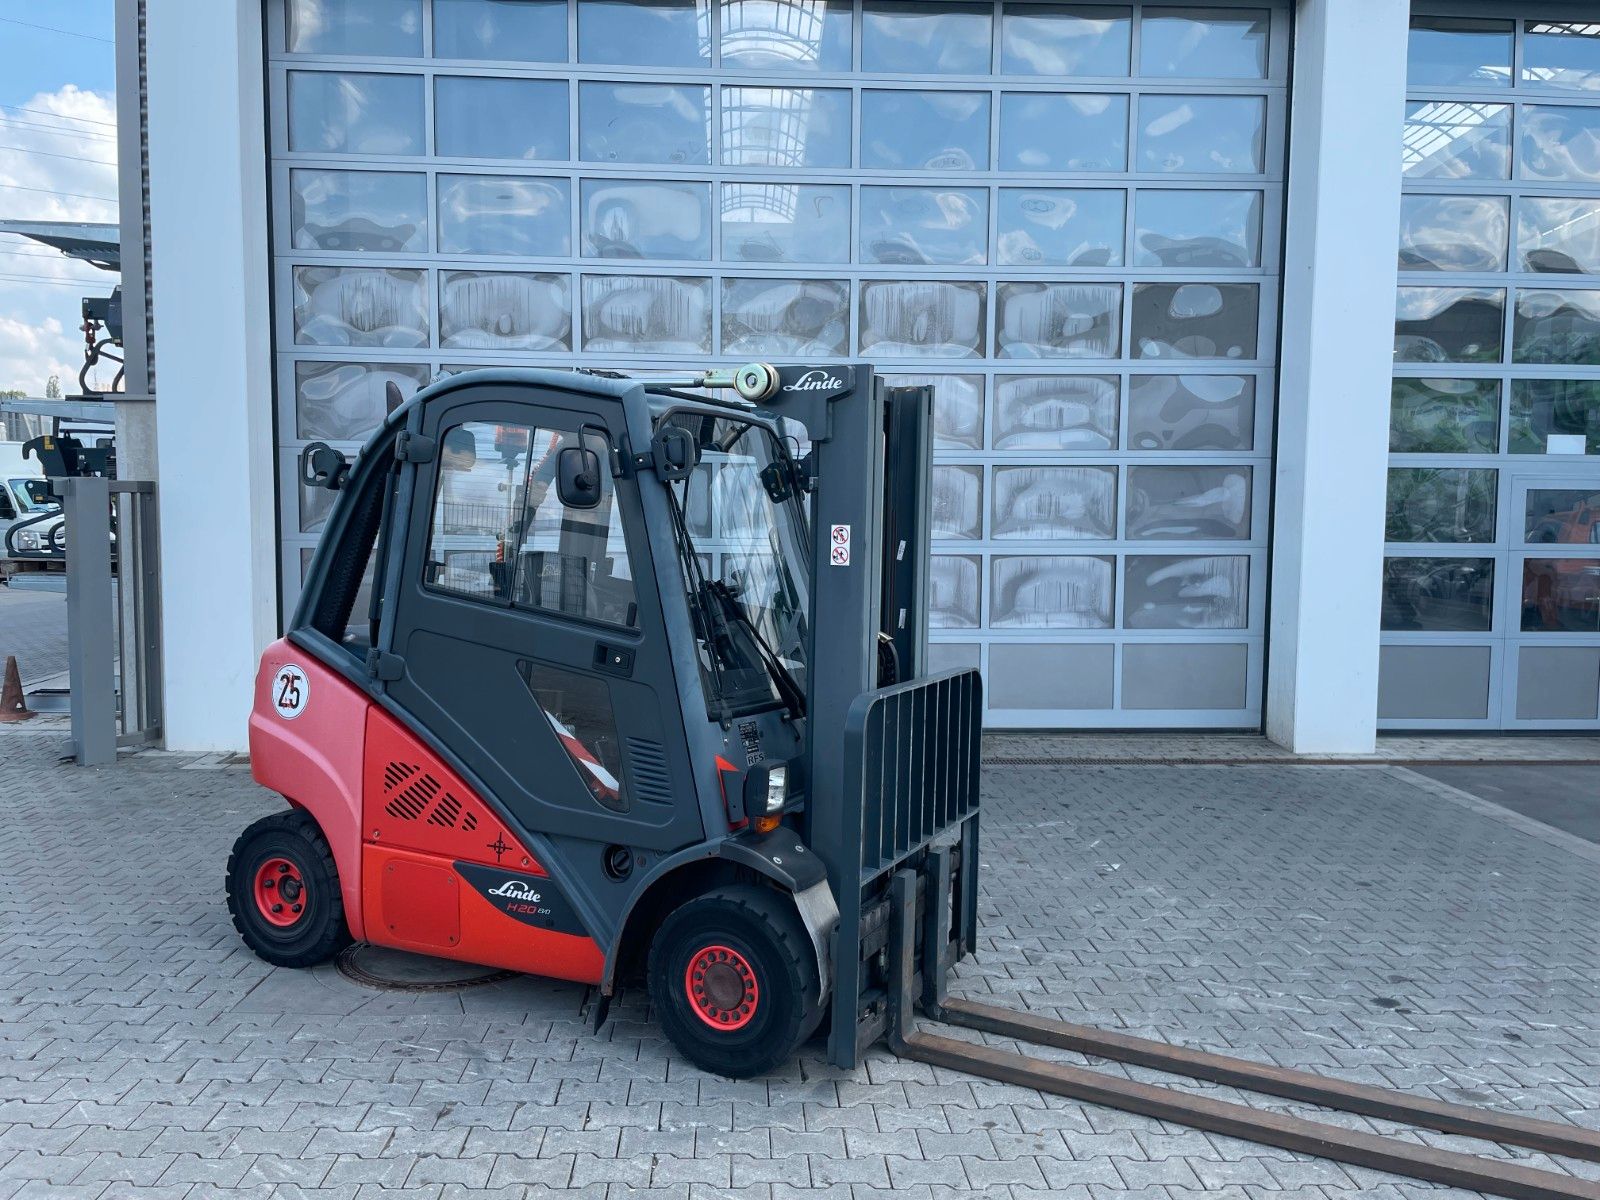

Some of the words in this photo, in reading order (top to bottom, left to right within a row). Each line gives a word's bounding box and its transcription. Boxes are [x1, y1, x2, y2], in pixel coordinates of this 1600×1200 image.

[782, 370, 843, 392] Linde
[278, 674, 301, 709] 25
[488, 880, 541, 903] Linde
[506, 902, 538, 914] H20
